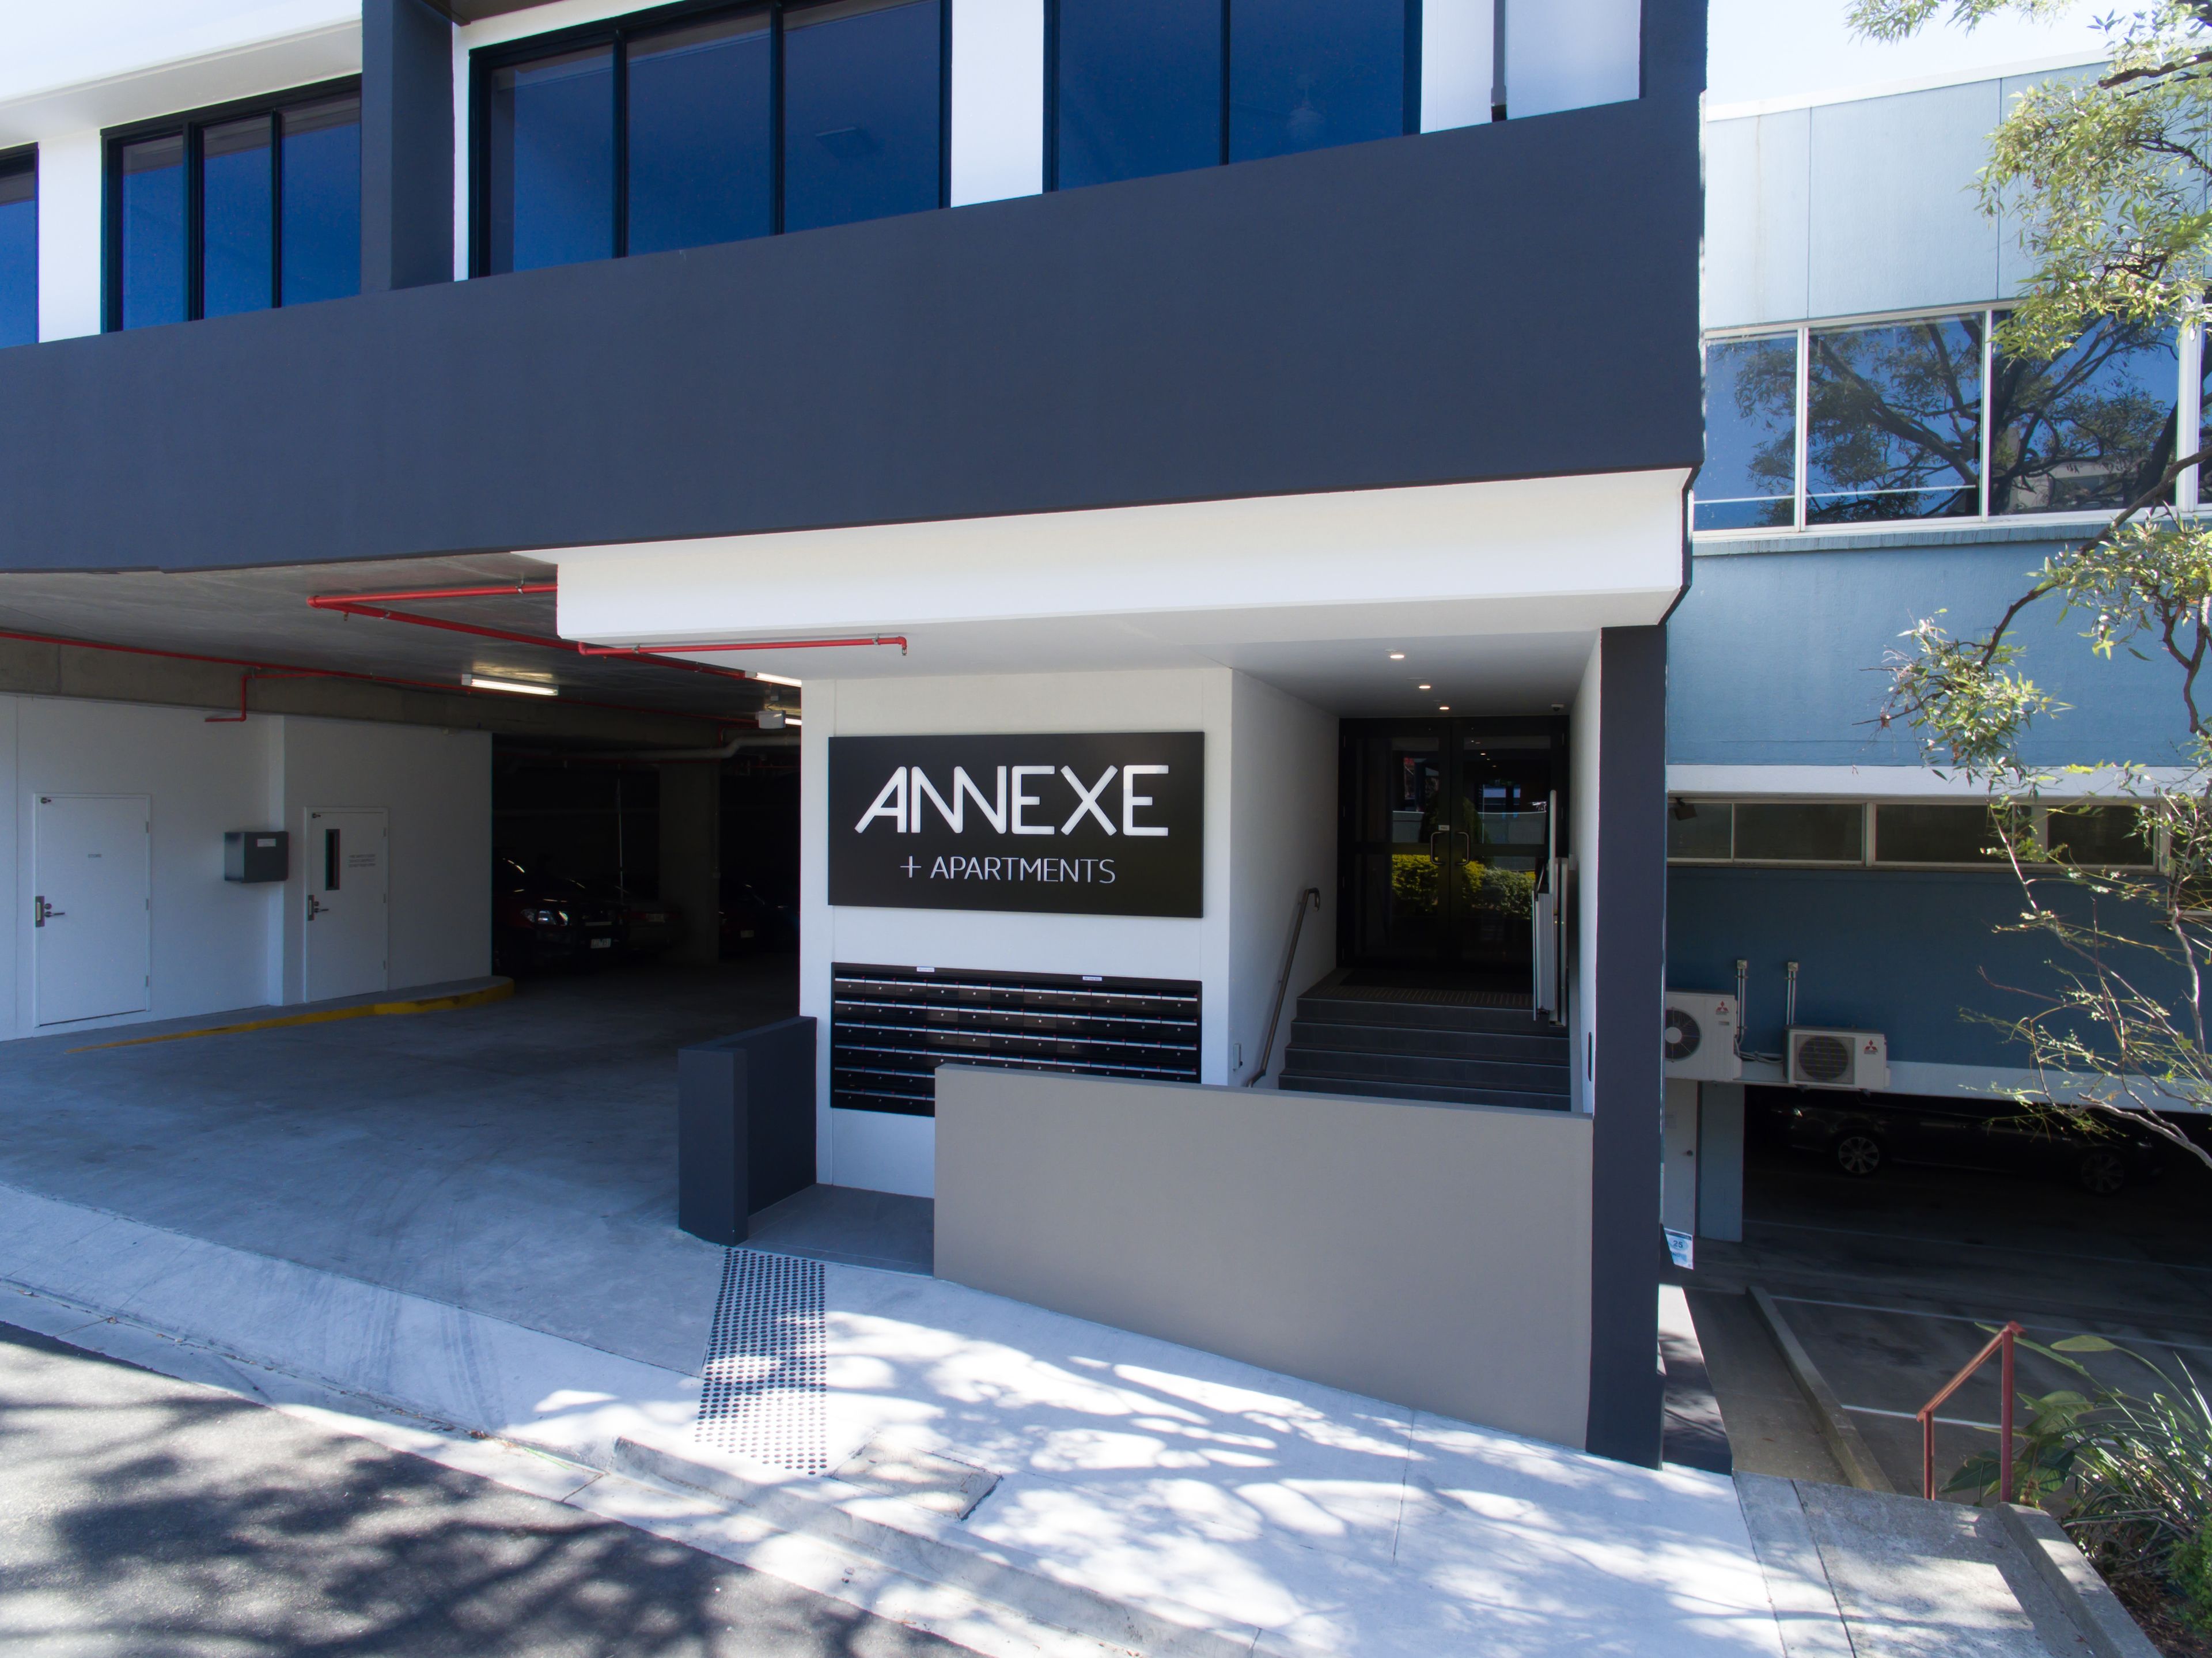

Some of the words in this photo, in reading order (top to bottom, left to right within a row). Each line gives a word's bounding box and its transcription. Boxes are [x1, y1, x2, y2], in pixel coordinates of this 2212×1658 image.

[854, 764, 1169, 836] ANNEXE
[900, 856, 922, 878] +
[930, 856, 1115, 884] APARTMENTS
[1673, 1240, 1683, 1248] 25
